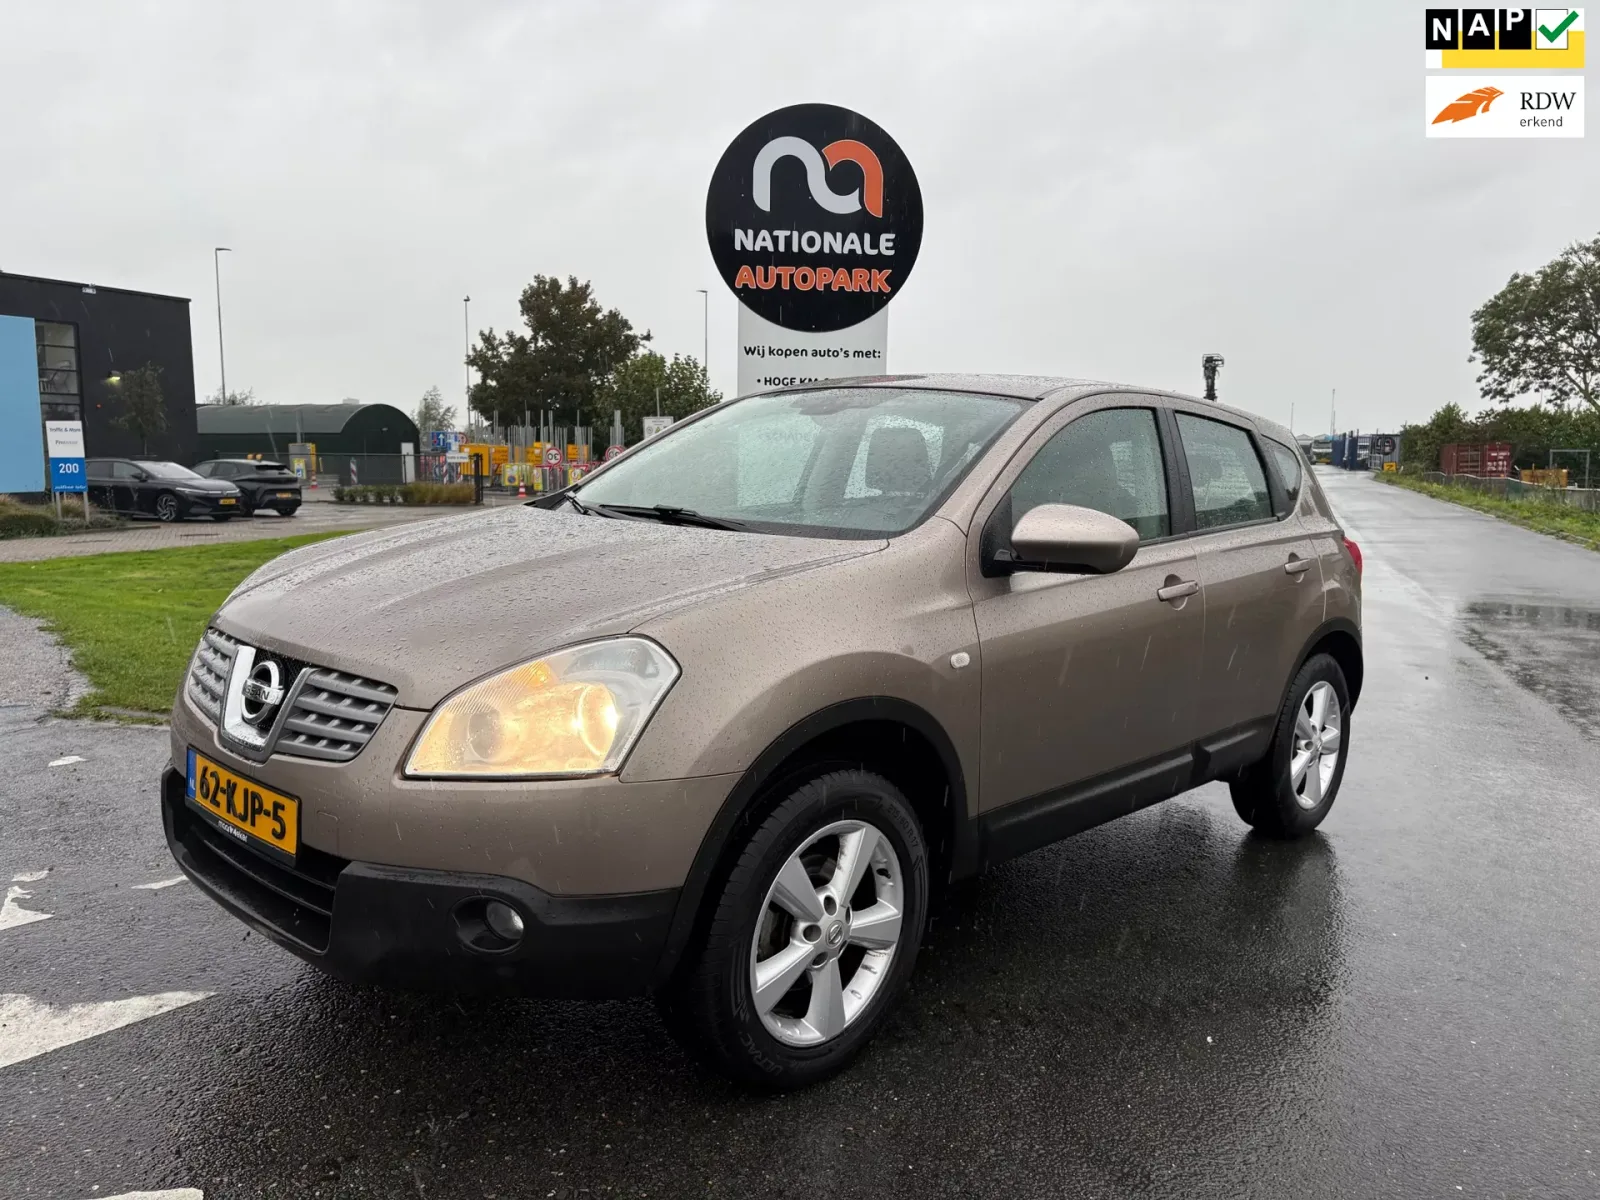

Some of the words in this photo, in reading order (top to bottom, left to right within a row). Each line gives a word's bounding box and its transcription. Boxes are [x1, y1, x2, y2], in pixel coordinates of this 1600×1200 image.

[734, 228, 896, 256] NATIONALE
[735, 265, 892, 293] AUTOPARK
[743, 346, 765, 358] Wij
[768, 346, 808, 359] kopen
[811, 347, 850, 358] auto's
[852, 349, 881, 359] met:
[764, 376, 796, 386] HOGE
[58, 463, 79, 473] 200
[199, 765, 287, 841] 62-KJP-5
